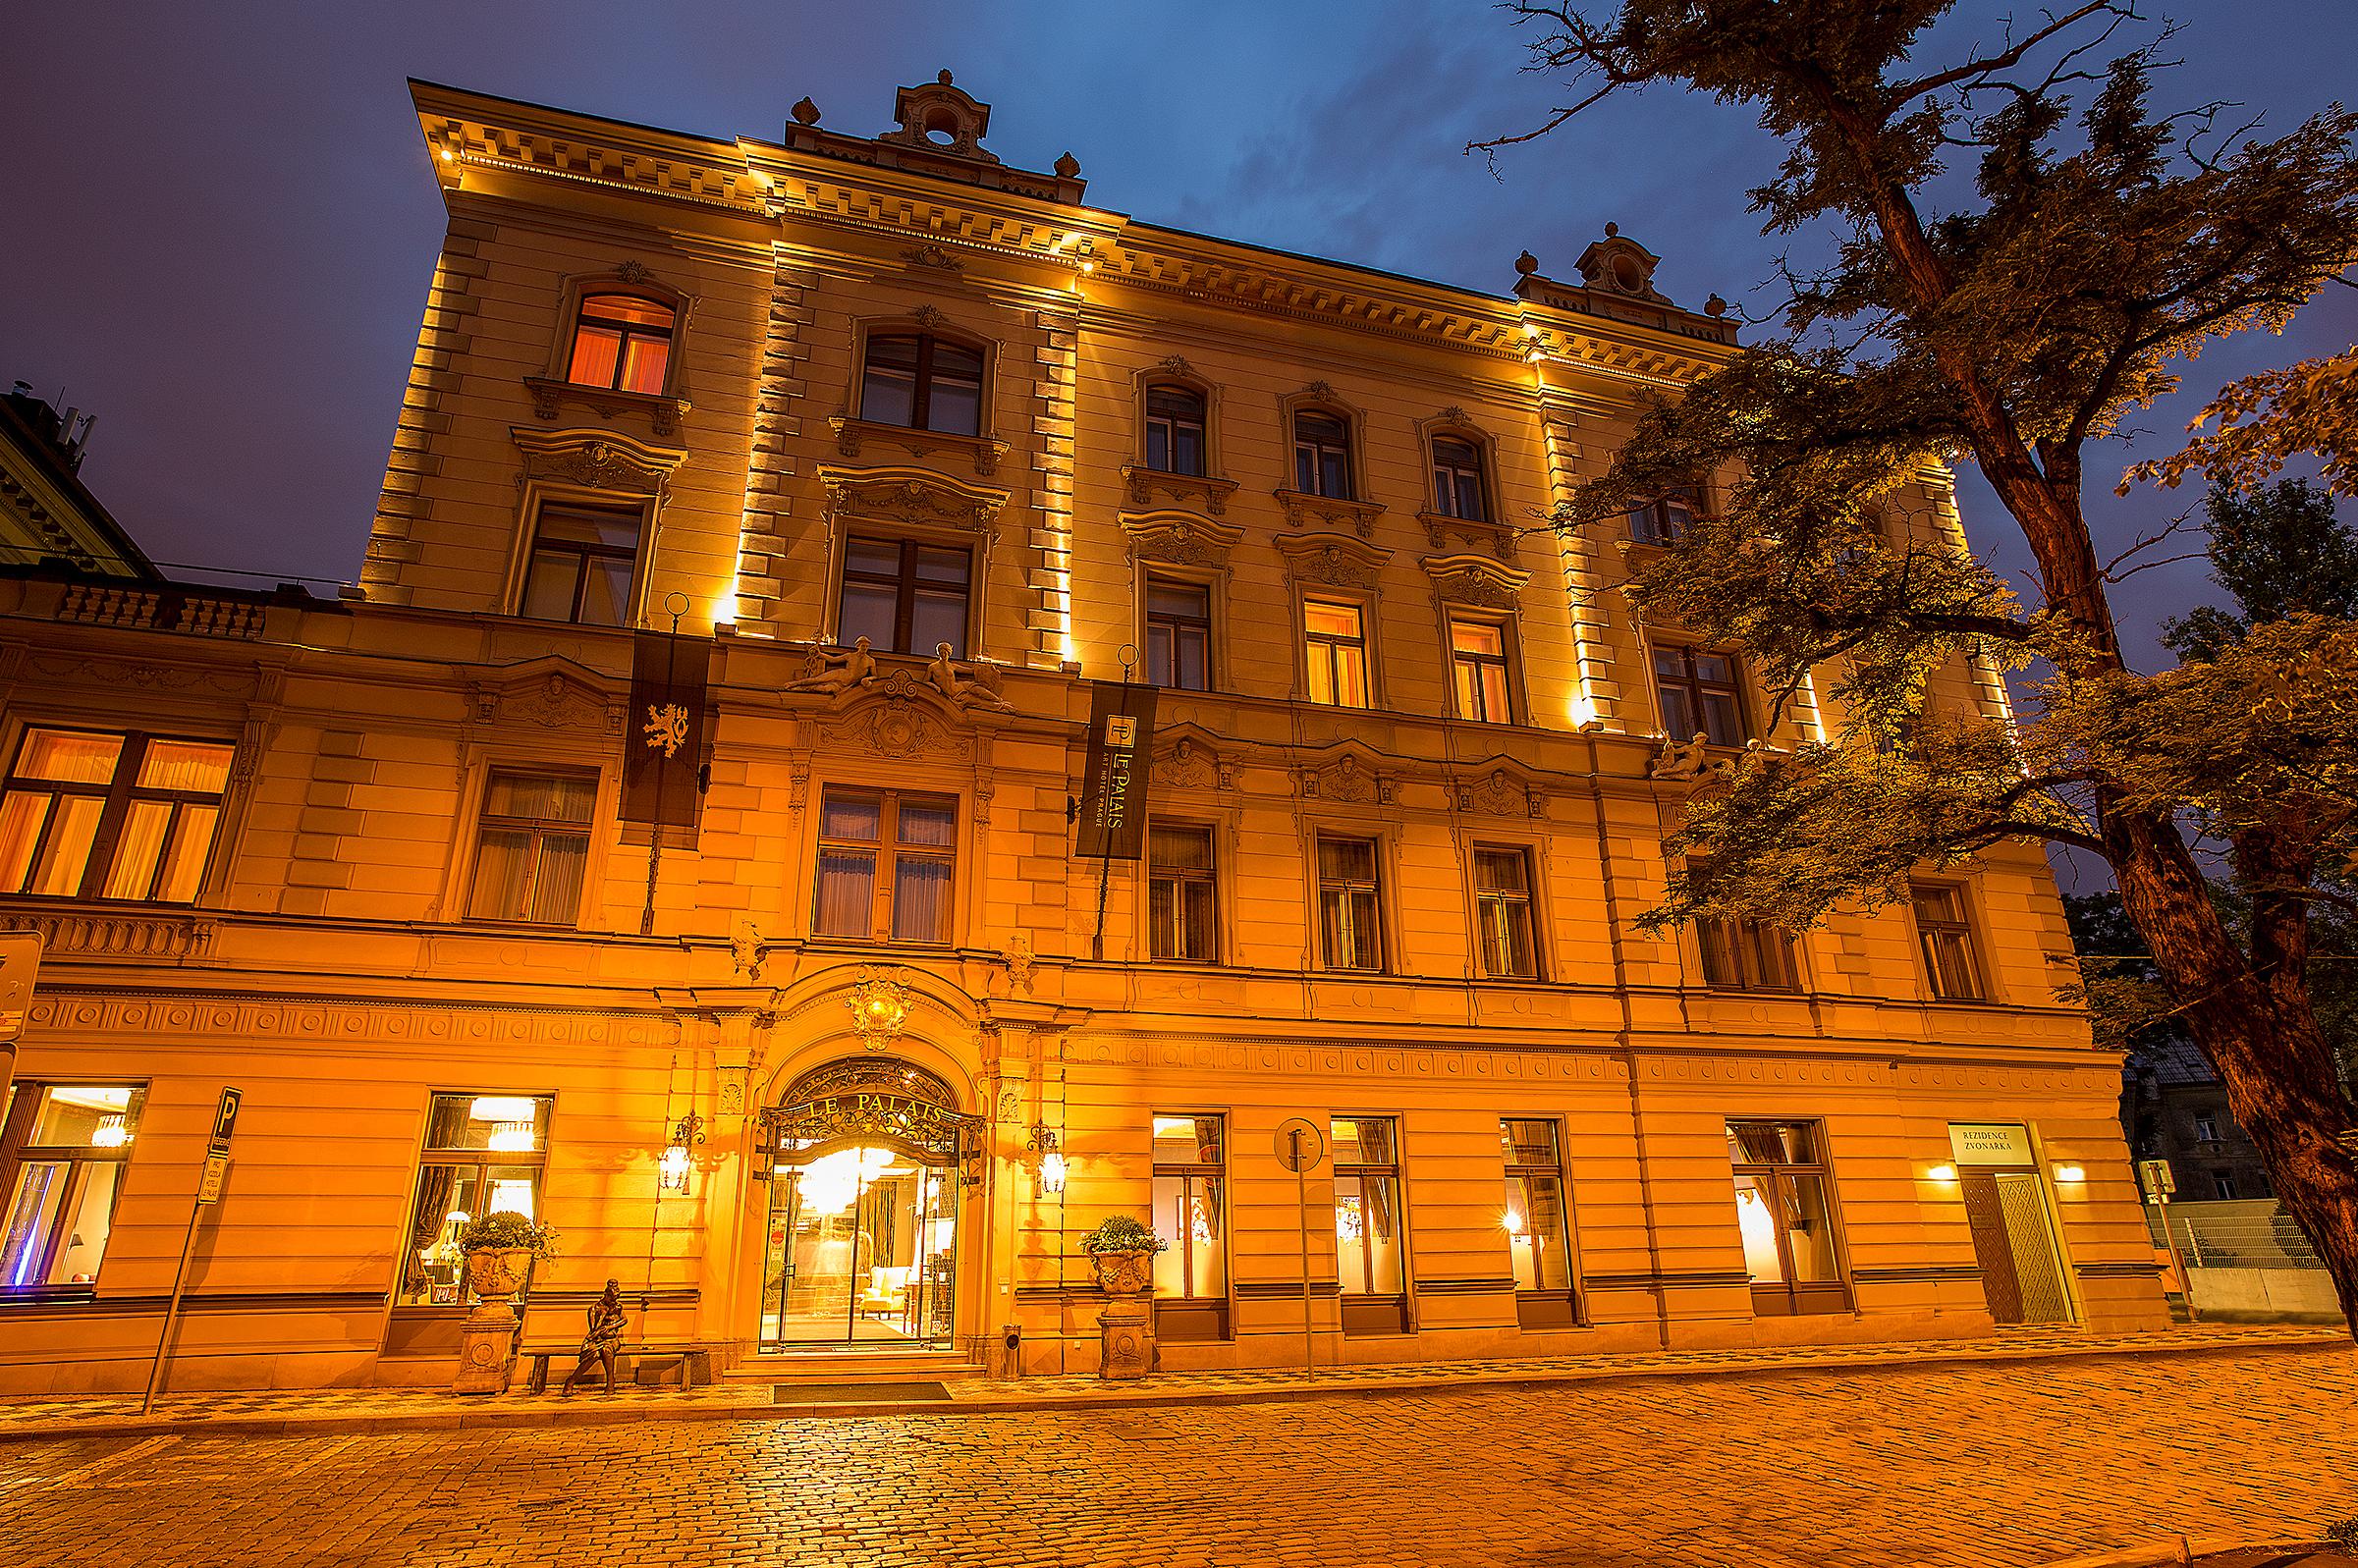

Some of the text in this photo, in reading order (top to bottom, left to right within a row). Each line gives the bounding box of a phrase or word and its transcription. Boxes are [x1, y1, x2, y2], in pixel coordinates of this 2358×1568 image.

[1099, 770, 1108, 794] HOTEL
[1107, 753, 1133, 829] LE PALAIS
[1095, 797, 1105, 828] PRAGUE
[219, 1096, 236, 1132] P
[809, 1094, 945, 1122] LE PALAIS
[1962, 1131, 2008, 1140] REZIDENCE
